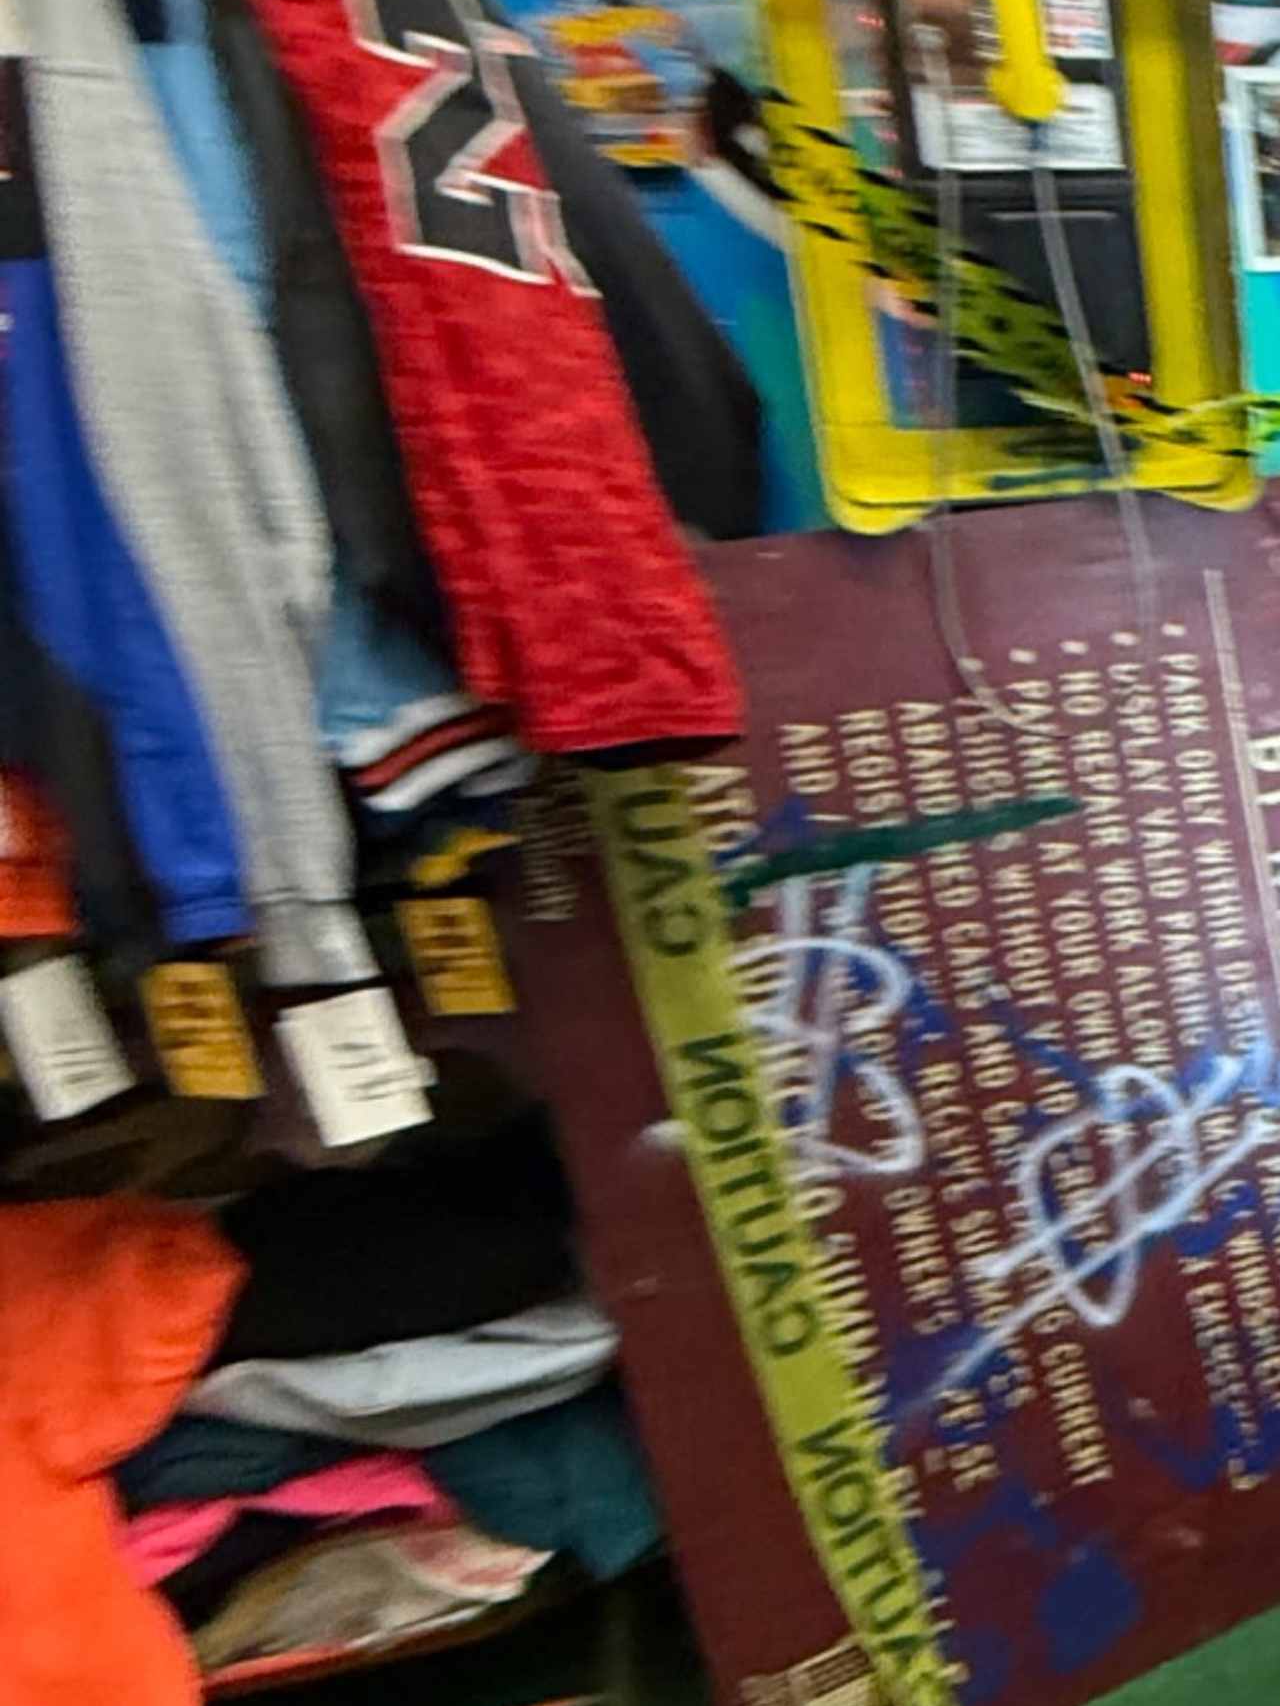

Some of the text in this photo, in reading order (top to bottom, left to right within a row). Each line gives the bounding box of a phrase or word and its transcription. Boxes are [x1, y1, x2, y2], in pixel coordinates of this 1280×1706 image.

[1060, 675, 1105, 713] NO
[1161, 657, 1208, 733] PARK
[778, 730, 838, 791] AND
[1007, 684, 1069, 796] PARKIN
[1072, 732, 1129, 846] REPAIR
[1177, 753, 1225, 820] ONLY
[1039, 845, 1084, 869] AT
[1138, 807, 1189, 896] VALID
[1195, 839, 1246, 945] WITHIN
[991, 864, 1058, 1003] WITHOUT
[1049, 891, 1104, 975] YOUR
[1096, 859, 1148, 950] WORK
[838, 712, 931, 951] REGISTATION
[915, 1063, 988, 1201] RECEIVE
[1158, 914, 1213, 1043] PARKING
[1068, 992, 1118, 1060] OWN
[898, 707, 981, 904] ABANDNED
[965, 1028, 1017, 1087] AND
[1042, 1342, 1111, 1485] CURRENT
